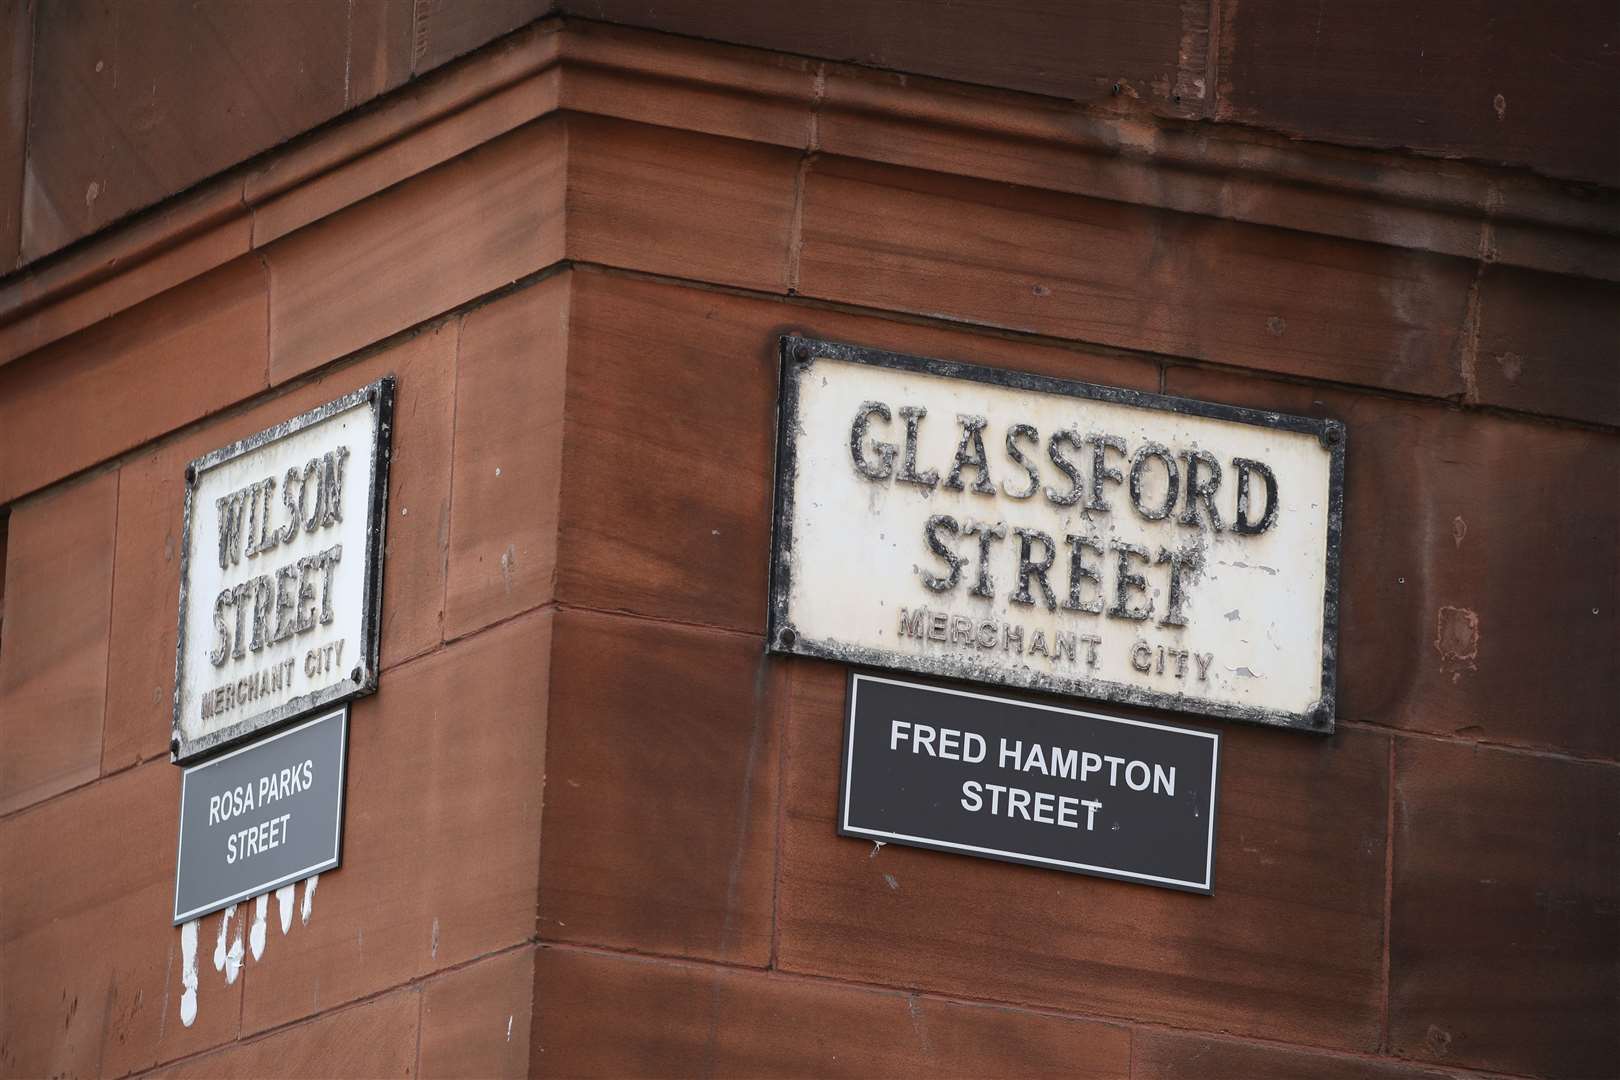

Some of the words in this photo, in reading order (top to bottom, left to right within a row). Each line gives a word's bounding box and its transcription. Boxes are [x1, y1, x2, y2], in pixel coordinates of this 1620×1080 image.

[849, 400, 1280, 536] GLASSFORD
[215, 446, 350, 570] WILSON
[210, 544, 343, 667] STREET
[921, 514, 1201, 628] STREET
[200, 657, 295, 721] MERCHANT
[304, 639, 345, 678] CITY
[899, 607, 1102, 665] MERCHANT
[1130, 640, 1215, 682] CITY
[209, 783, 254, 826] ROSA
[258, 760, 313, 807] PARKS
[890, 720, 986, 764] FRED
[998, 738, 1176, 796] HAMPTON
[226, 814, 290, 864] STREET
[960, 781, 1102, 831] STREET
